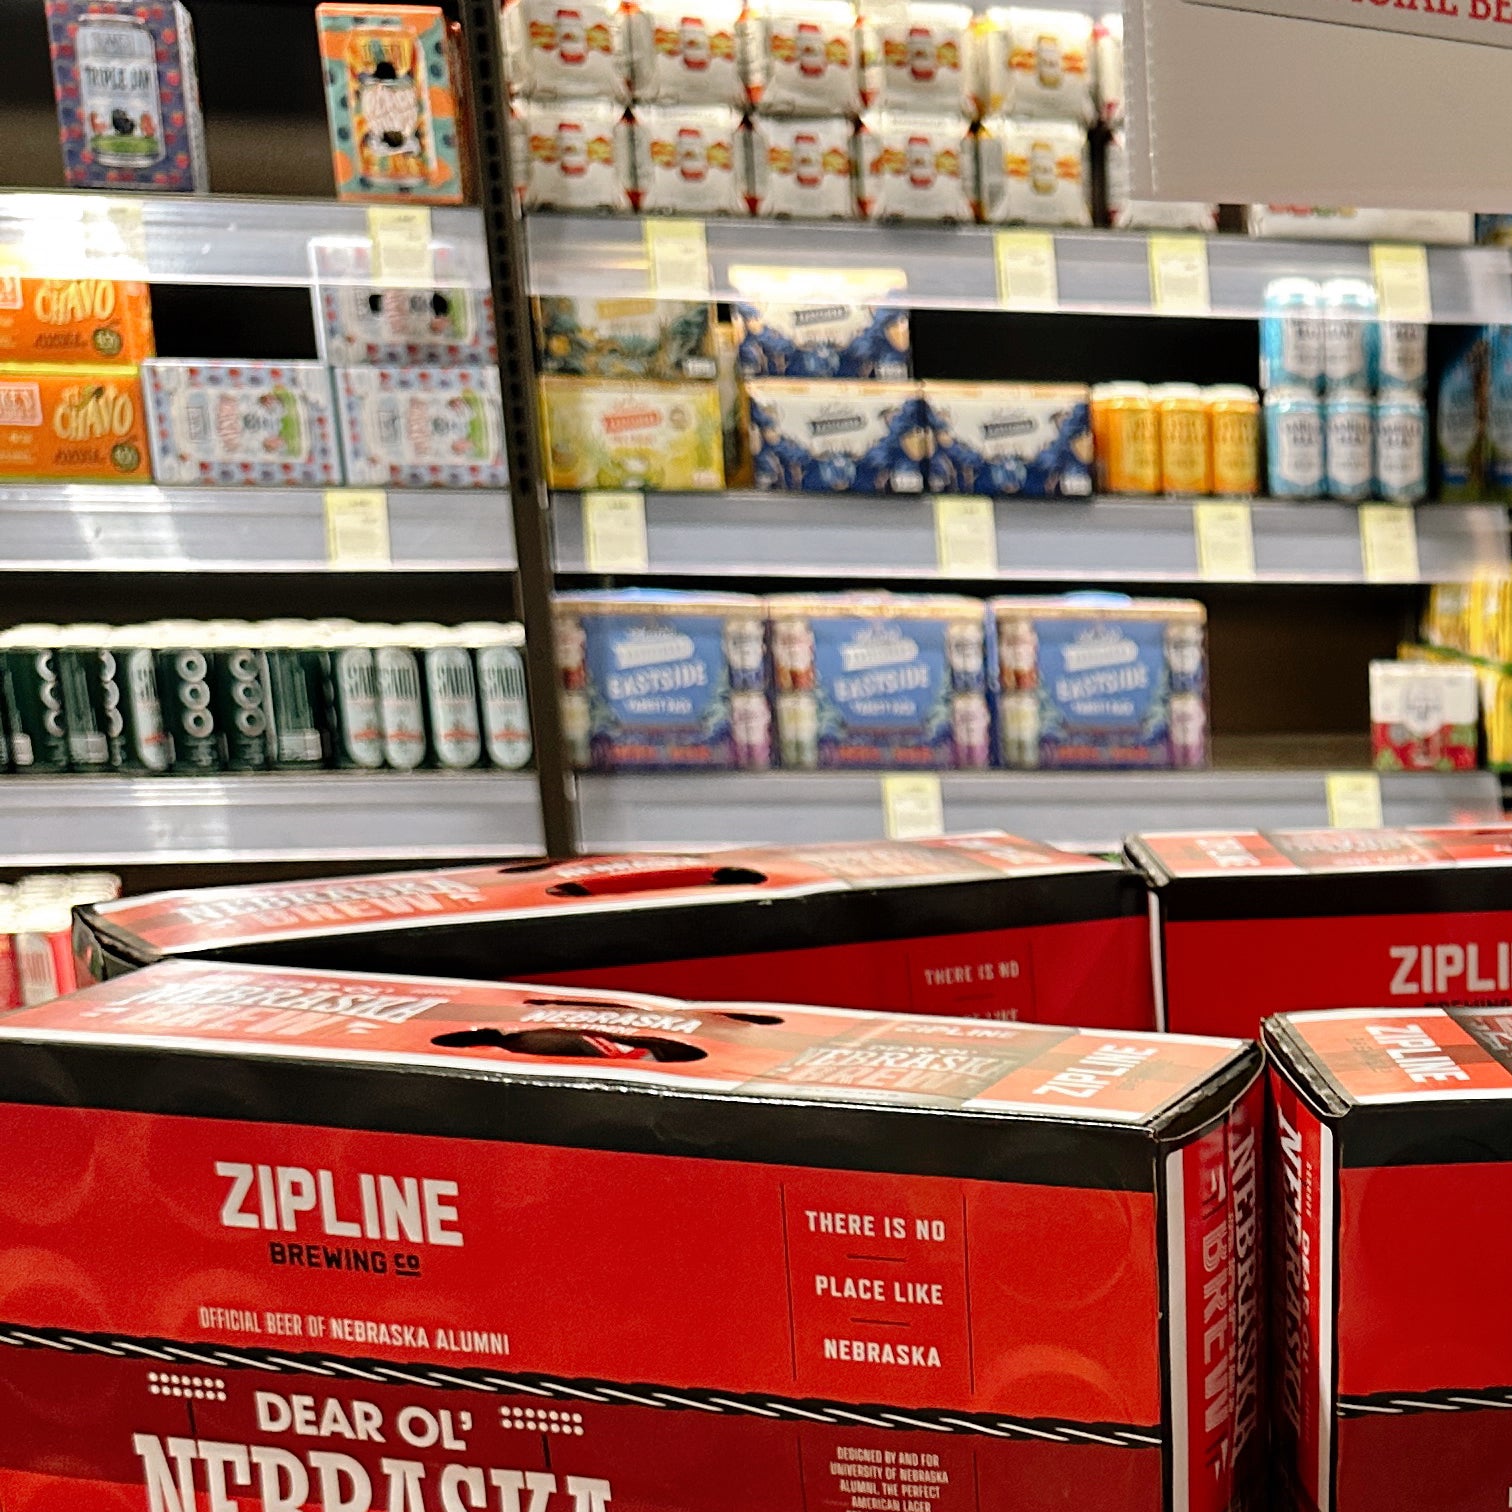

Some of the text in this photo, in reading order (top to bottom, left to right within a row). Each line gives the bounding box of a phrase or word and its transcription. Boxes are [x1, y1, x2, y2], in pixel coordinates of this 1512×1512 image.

[1033, 1042, 1159, 1099] ZIPLINE
[1366, 1024, 1470, 1084] ZIPLINE
[216, 1160, 464, 1248] ZIPLINE
[804, 1209, 947, 1244] THERE IS NO
[269, 1241, 388, 1274] BREWING
[815, 1274, 945, 1307] PLACE LIKE
[199, 1305, 511, 1357] OFFICIAL BEER OF NEBRASKA ALUMNI
[1203, 1224, 1231, 1434] BREW
[823, 1337, 942, 1369] NEBRASKA
[255, 1391, 472, 1452] DEAR OL'
[836, 1446, 883, 1464] DESIGNED
[829, 1461, 949, 1484] UNIVERSITY NEBRASKA
[851, 1495, 901, 1511] AMERICAN
[901, 1484, 941, 1499] PERFECT
